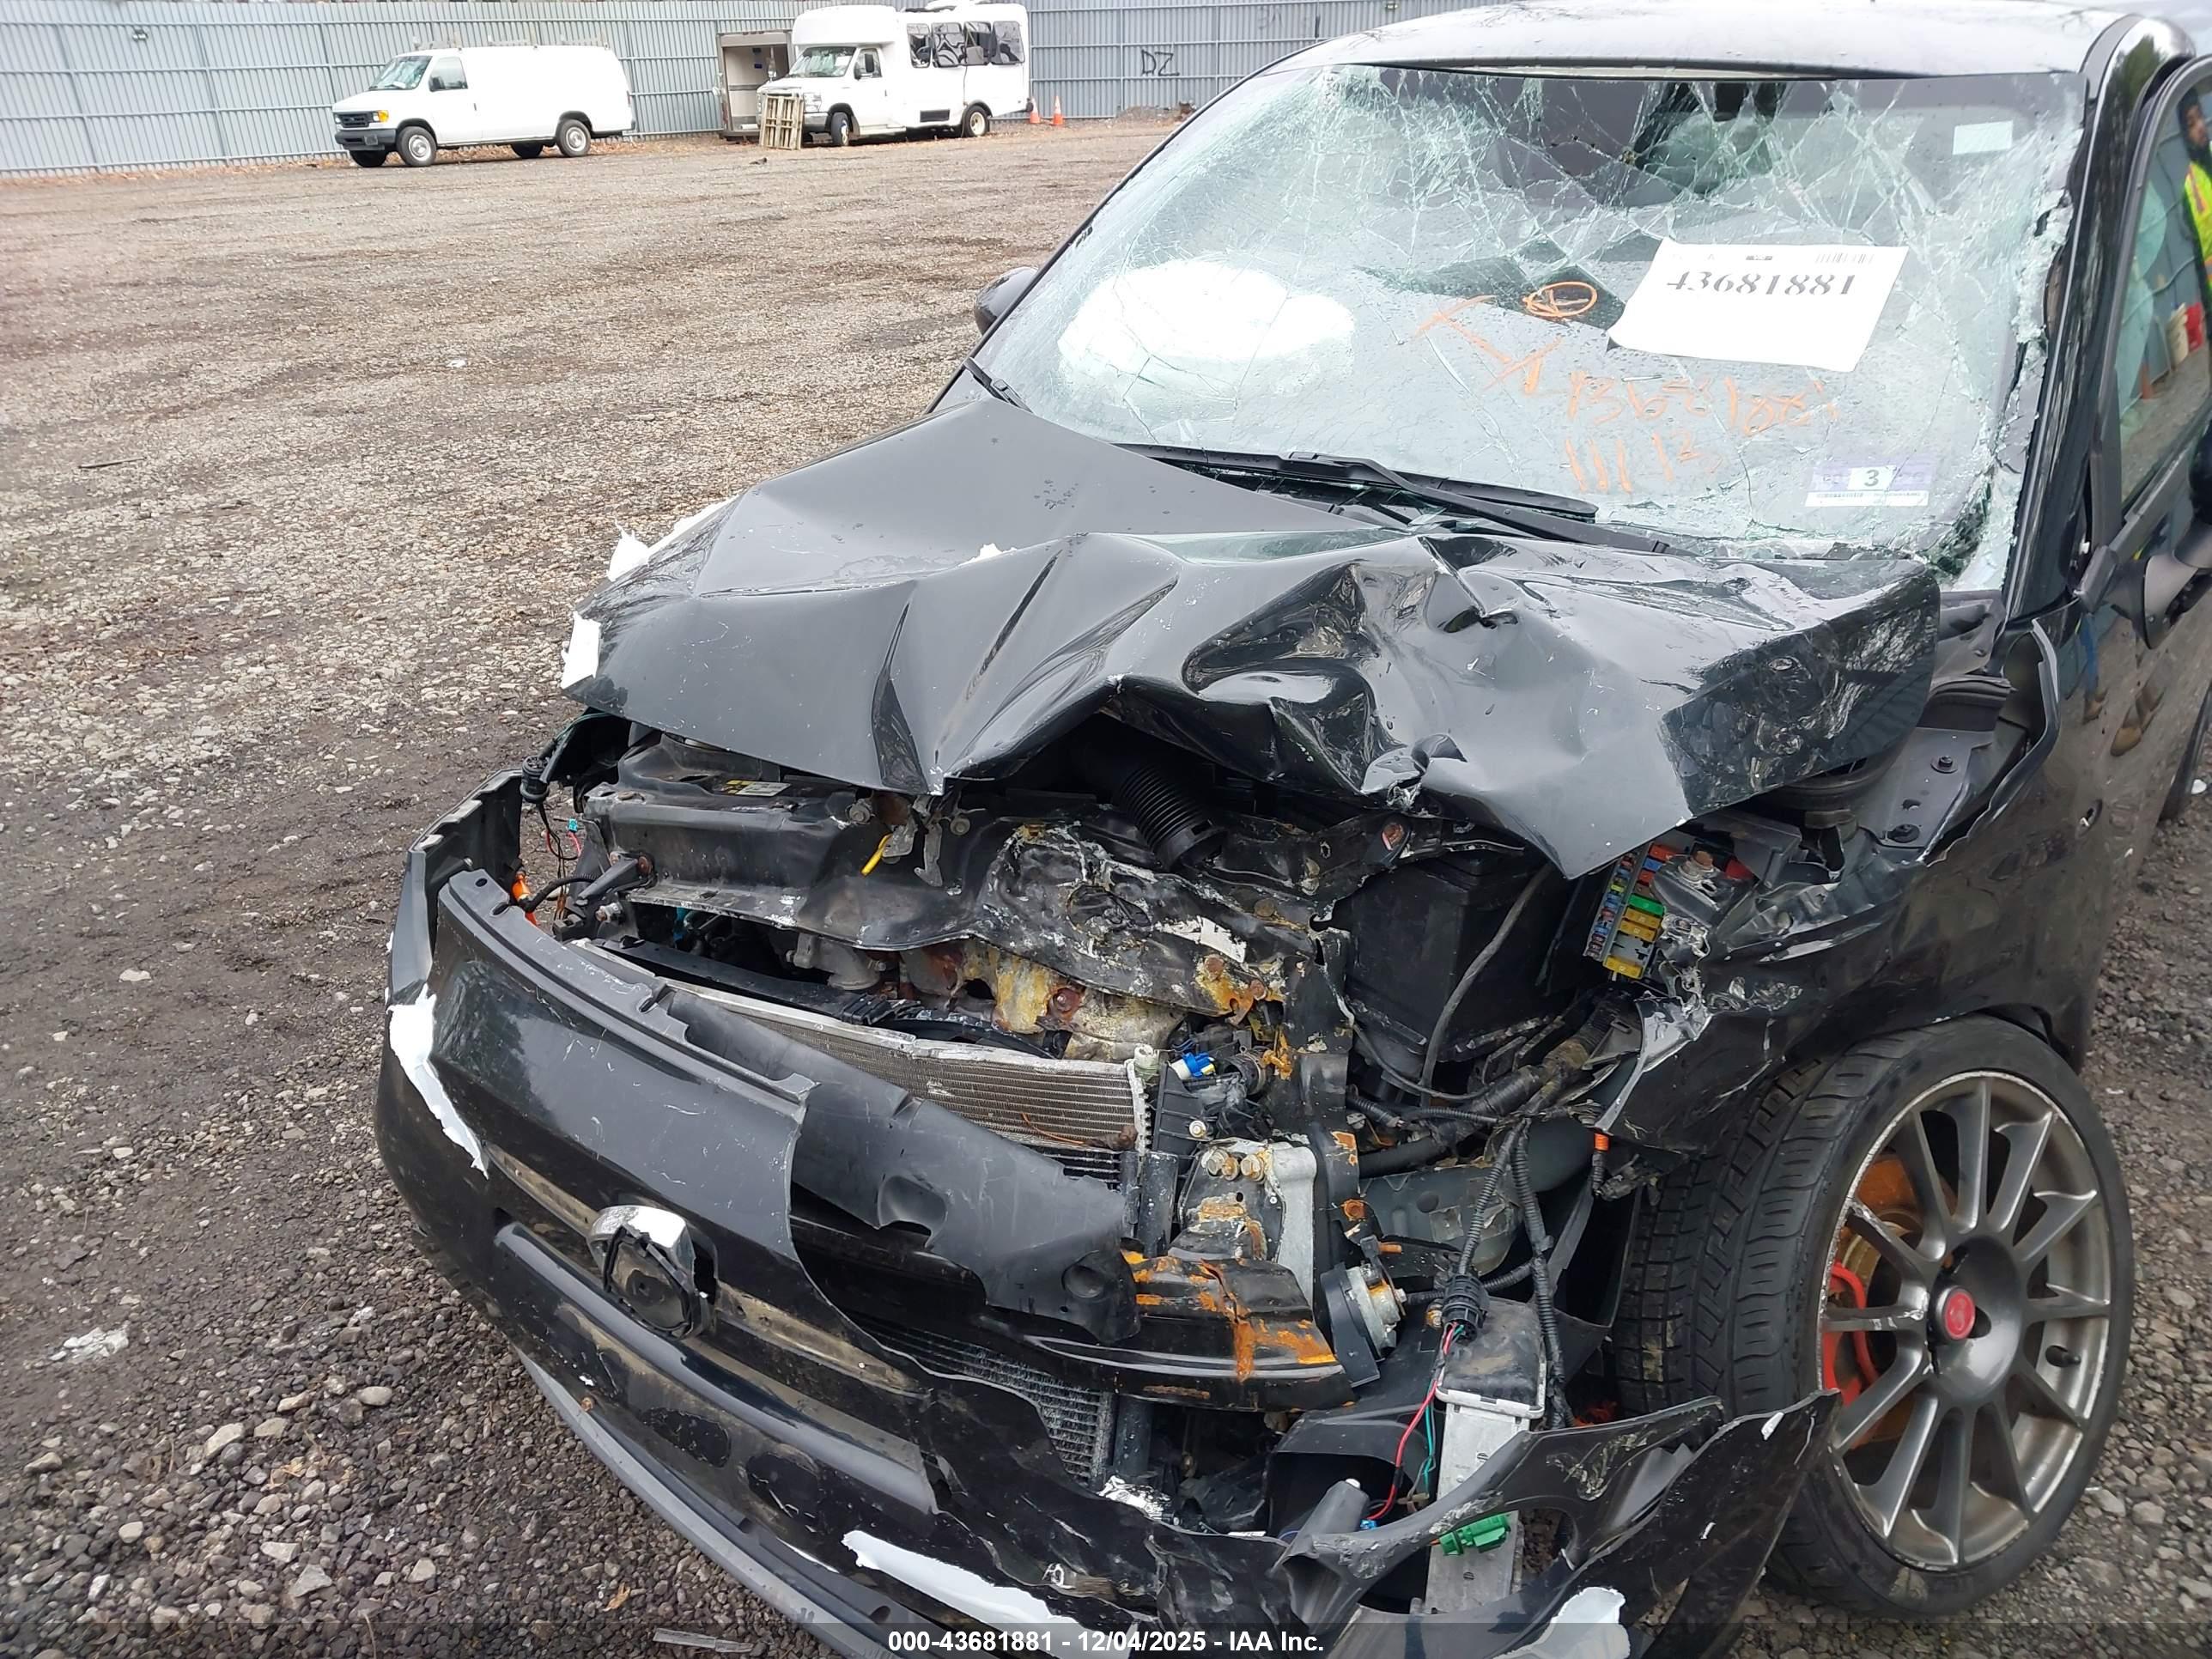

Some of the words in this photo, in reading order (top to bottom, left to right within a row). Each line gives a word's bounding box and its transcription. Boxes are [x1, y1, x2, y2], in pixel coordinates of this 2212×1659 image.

[1140, 49, 1180, 76] DZ
[1666, 270, 1856, 295] 43681881
[1863, 469, 1880, 487] 3
